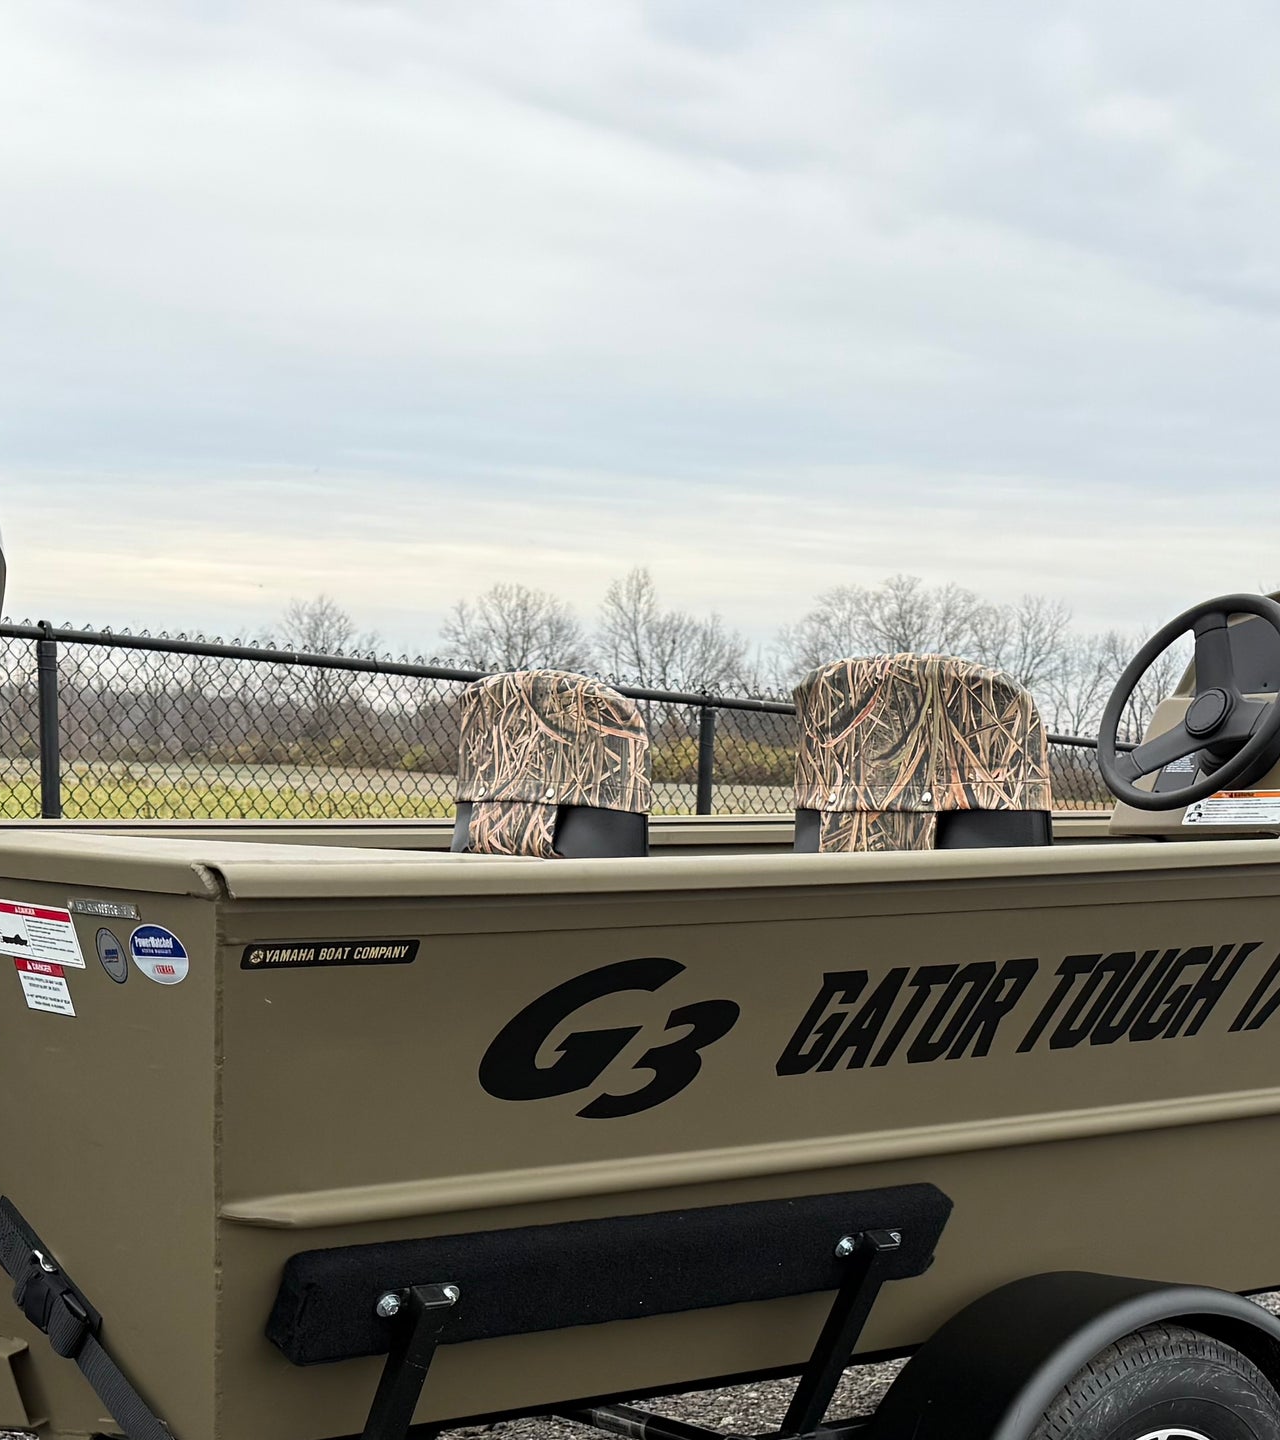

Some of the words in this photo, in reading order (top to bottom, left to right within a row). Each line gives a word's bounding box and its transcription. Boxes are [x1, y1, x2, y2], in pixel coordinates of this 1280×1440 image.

[265, 949, 315, 963] YAMAHA
[319, 947, 352, 961] BOAT
[353, 945, 410, 960] COMPANY
[776, 958, 1039, 1076] GATOR
[1016, 942, 1264, 1054] TOUGH
[479, 958, 740, 1119] G3
